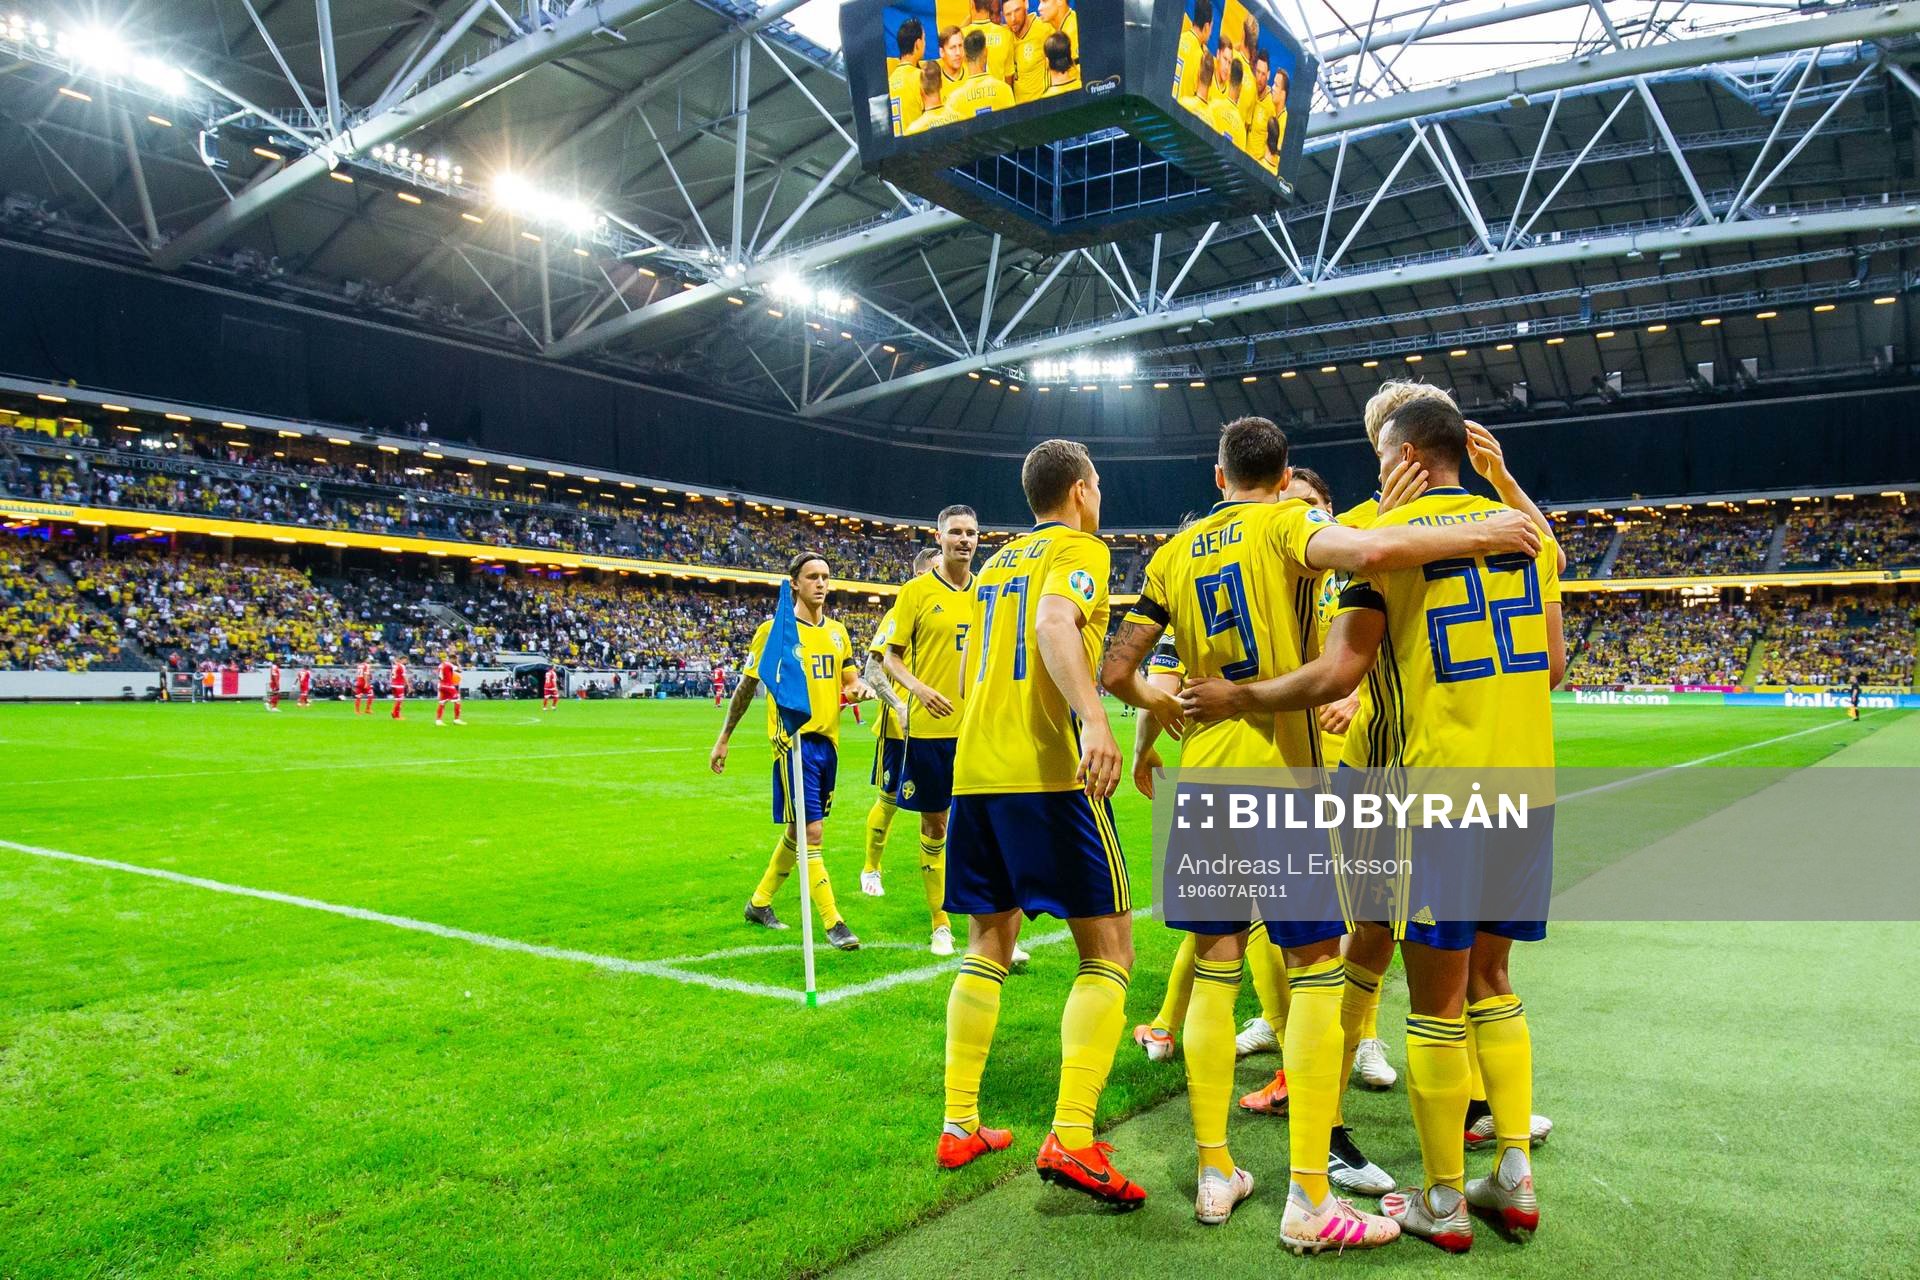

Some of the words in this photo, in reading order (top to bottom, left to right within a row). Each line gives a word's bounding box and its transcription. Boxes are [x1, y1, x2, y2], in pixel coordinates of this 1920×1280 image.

[1195, 562, 1259, 681] 9
[1422, 552, 1549, 683] 22
[811, 655, 834, 679] 20
[1154, 656, 1179, 667] RESPECT
